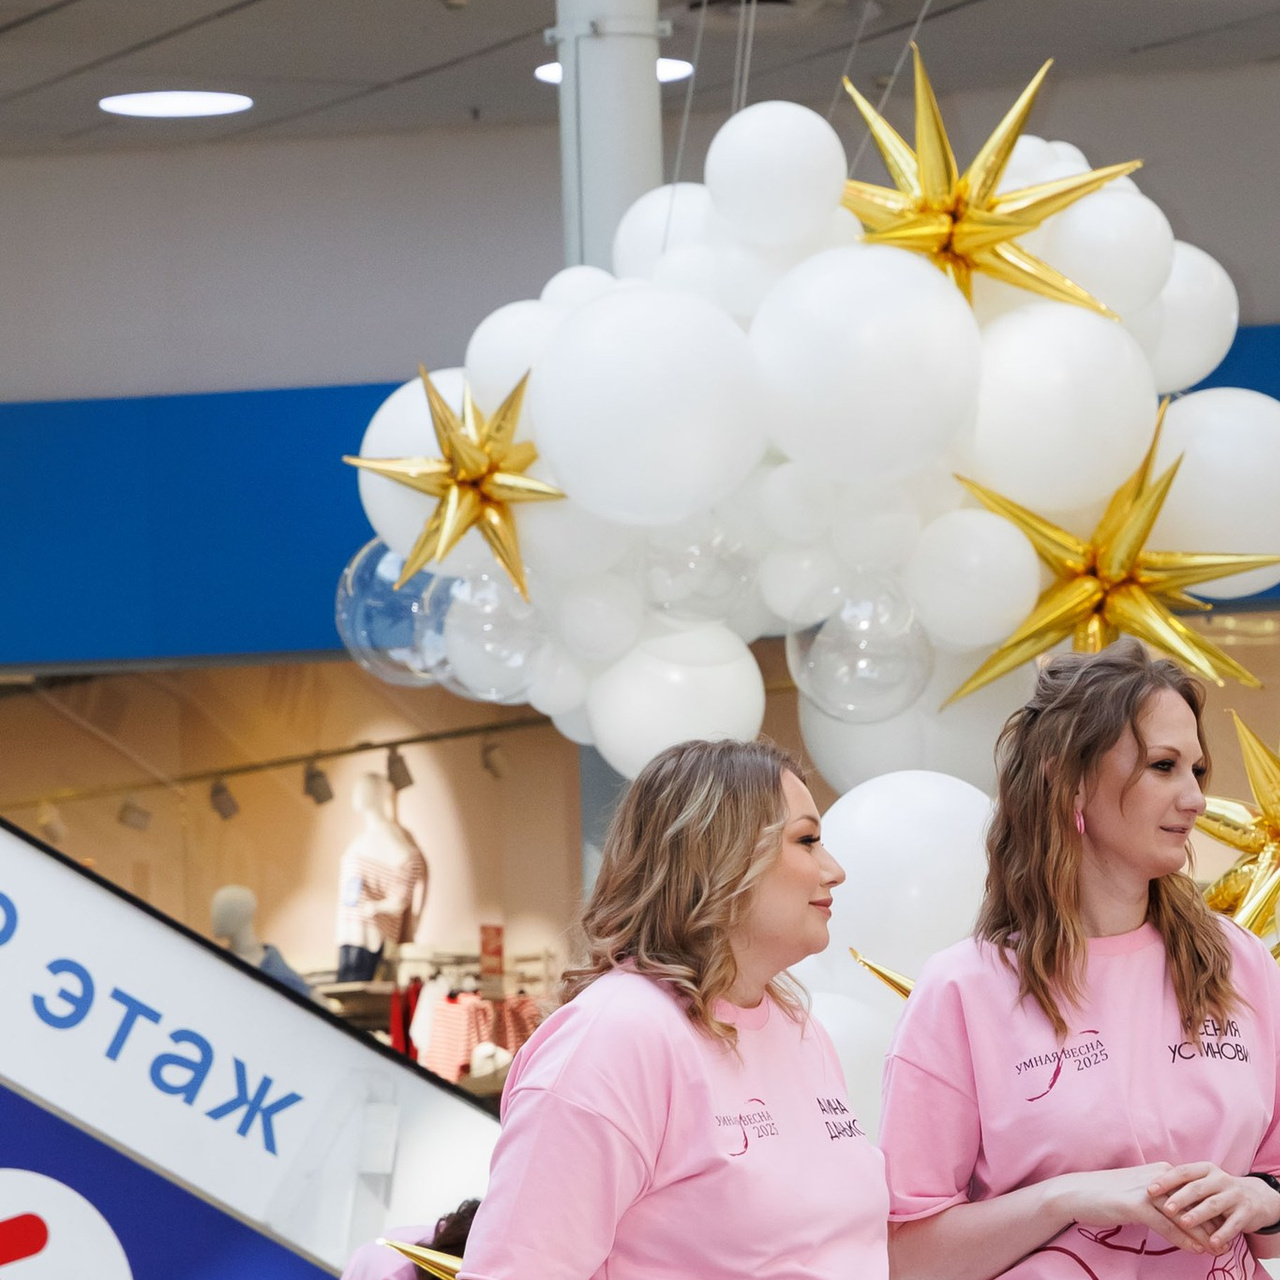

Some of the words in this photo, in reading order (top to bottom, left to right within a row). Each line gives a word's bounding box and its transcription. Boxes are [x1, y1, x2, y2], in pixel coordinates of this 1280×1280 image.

[32, 958, 303, 1156] этаж
[1015, 1051, 1060, 1075] УМНАЯ
[1063, 1039, 1104, 1059] ВЕСНА
[1074, 1048, 1109, 1072] 2025
